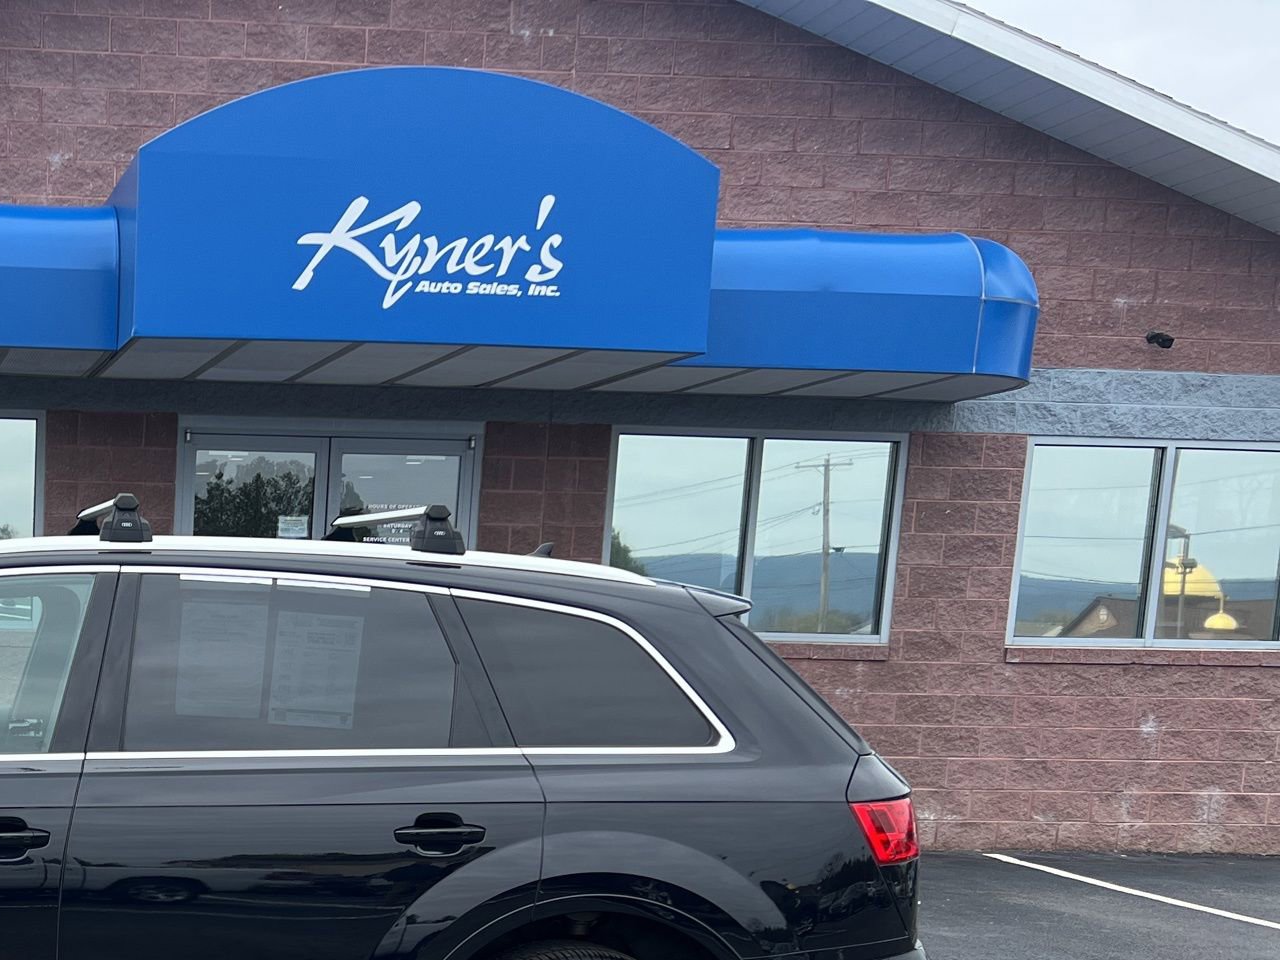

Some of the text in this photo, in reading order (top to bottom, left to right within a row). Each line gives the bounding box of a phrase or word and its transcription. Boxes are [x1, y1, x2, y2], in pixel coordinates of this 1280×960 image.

[291, 194, 563, 309] Kyner's
[414, 280, 560, 297] Auto Sales, Inc.
